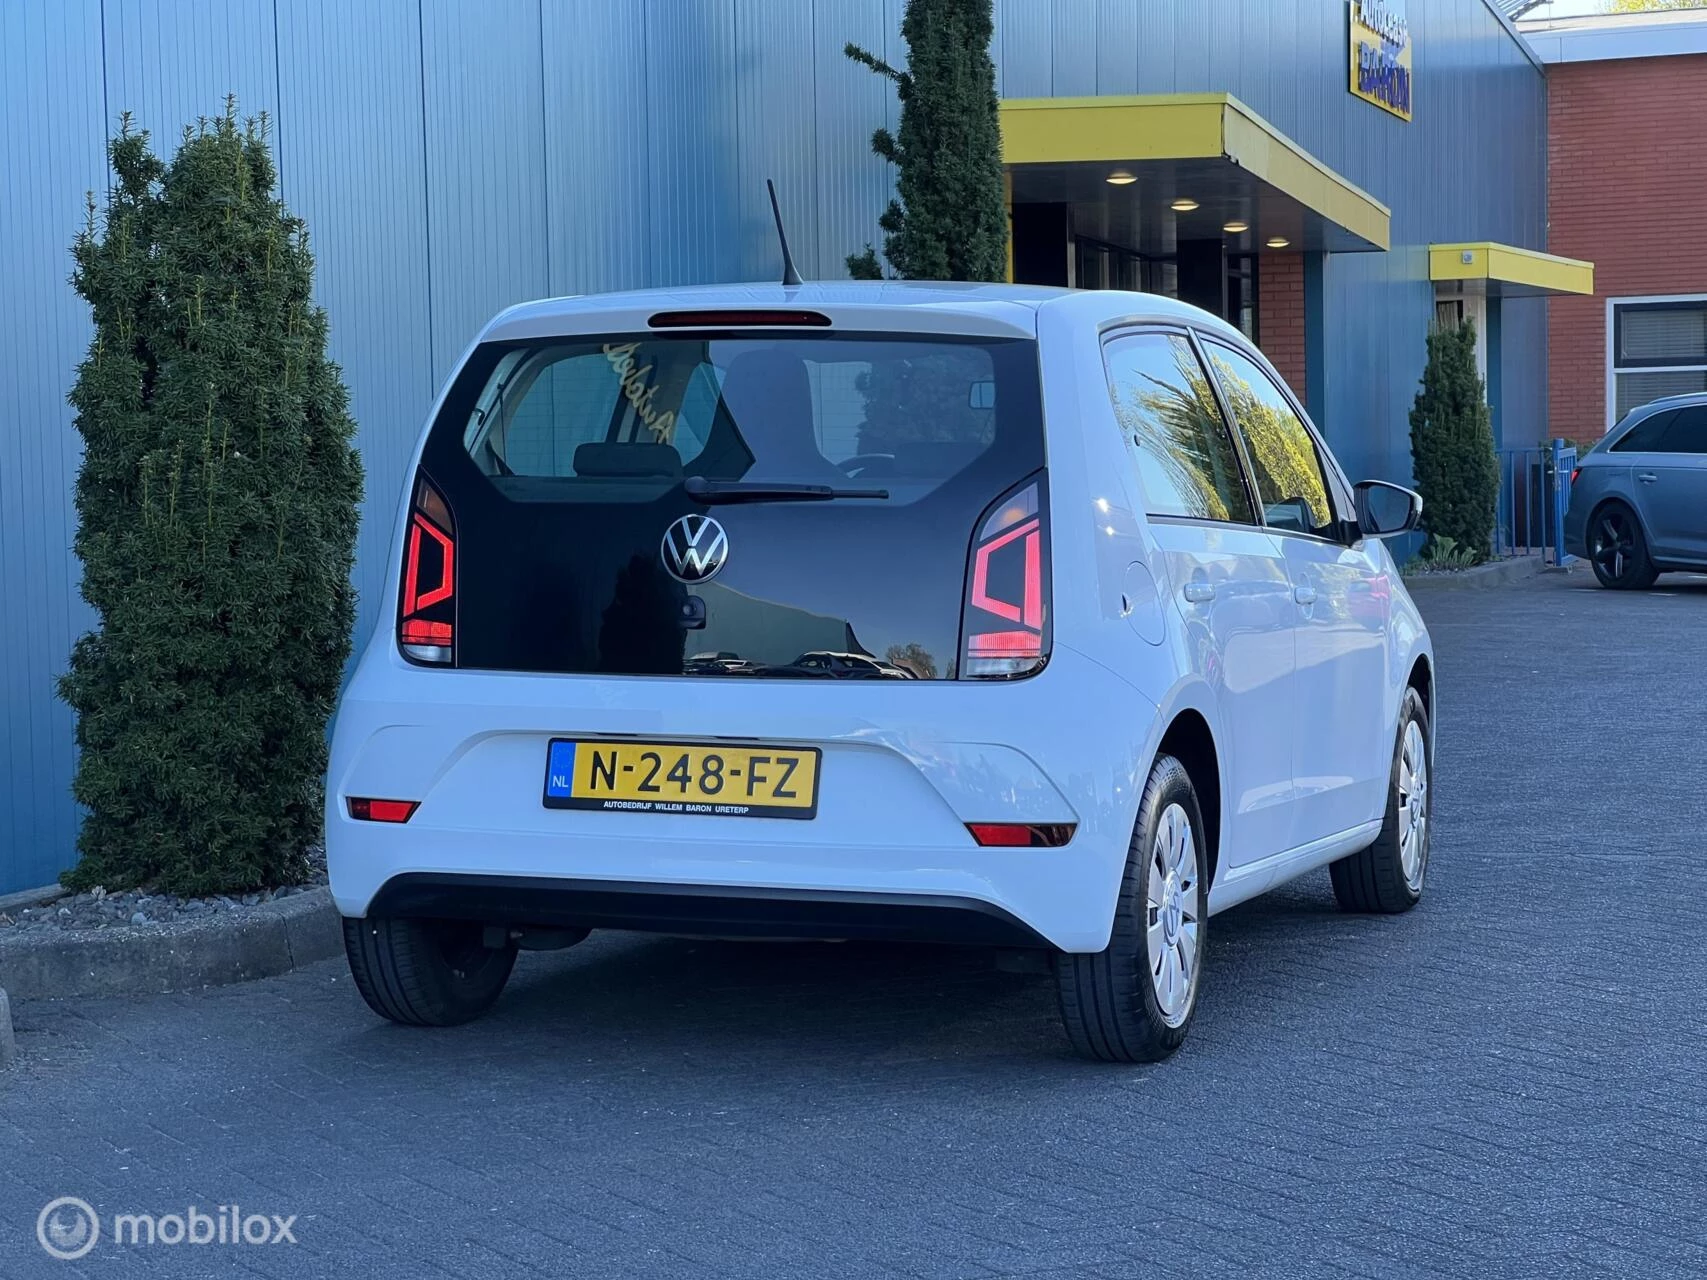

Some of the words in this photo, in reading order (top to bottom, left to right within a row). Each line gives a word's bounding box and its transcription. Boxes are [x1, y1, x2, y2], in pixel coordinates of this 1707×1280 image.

[1358, 41, 1410, 114] BARON
[552, 775, 569, 788] NL
[590, 750, 800, 798] N-248-FZ
[603, 801, 652, 811] AUTOBEDRIJF
[654, 803, 683, 812] WILLEM
[685, 805, 712, 813] BARON
[715, 806, 750, 815] URETERP
